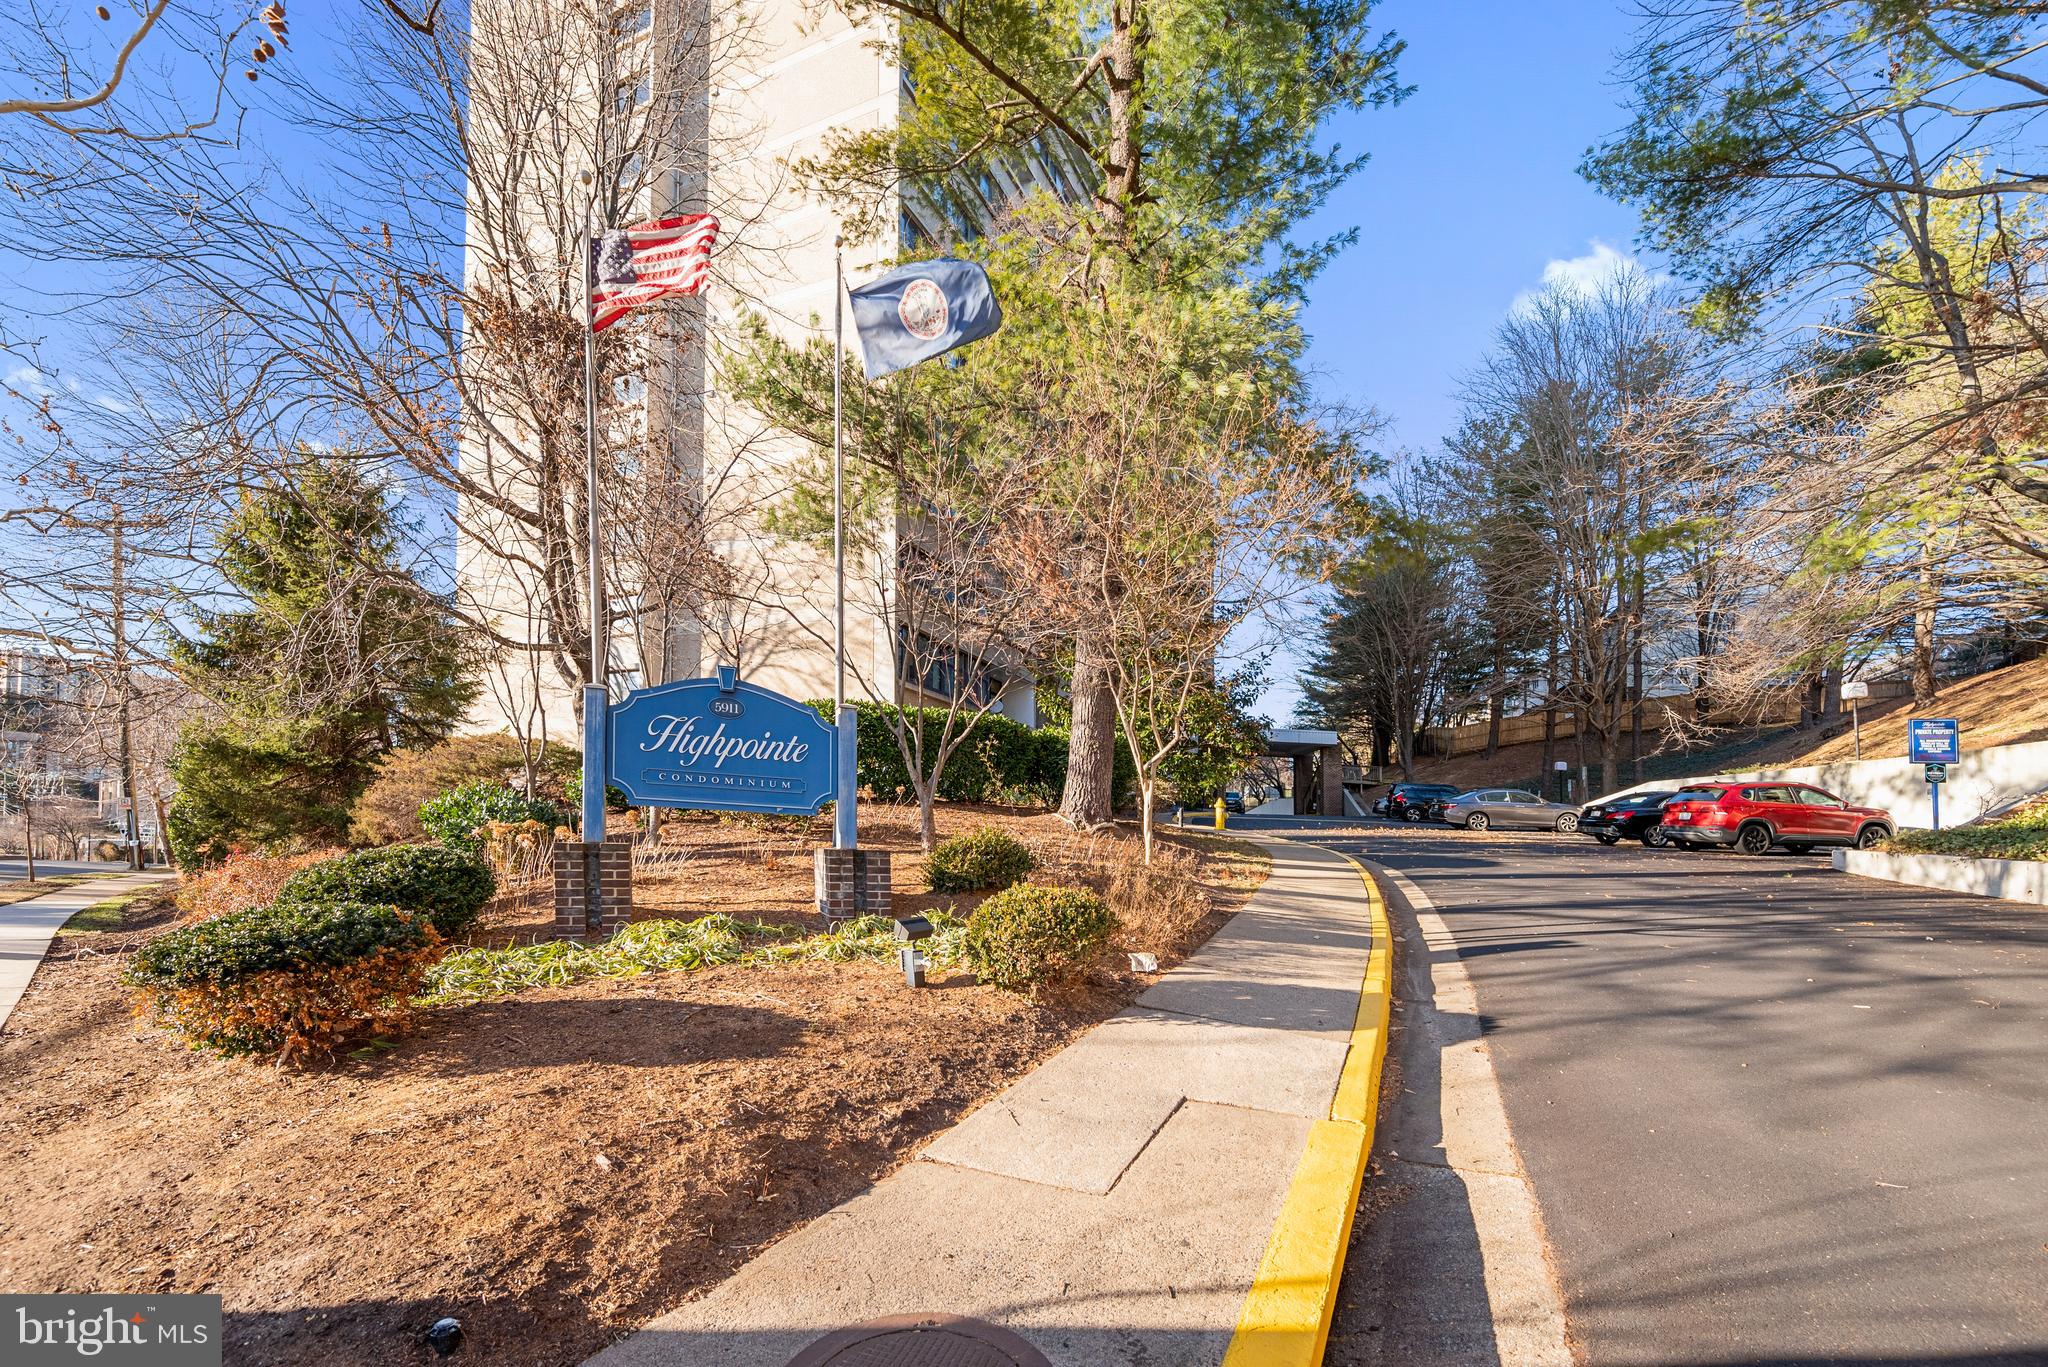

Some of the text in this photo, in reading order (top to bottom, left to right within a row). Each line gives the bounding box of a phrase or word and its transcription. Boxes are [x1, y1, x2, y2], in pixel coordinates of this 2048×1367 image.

[714, 702, 739, 714] 5911
[639, 714, 809, 768] Highpointe
[658, 773, 792, 789] CONDOMINIUM
